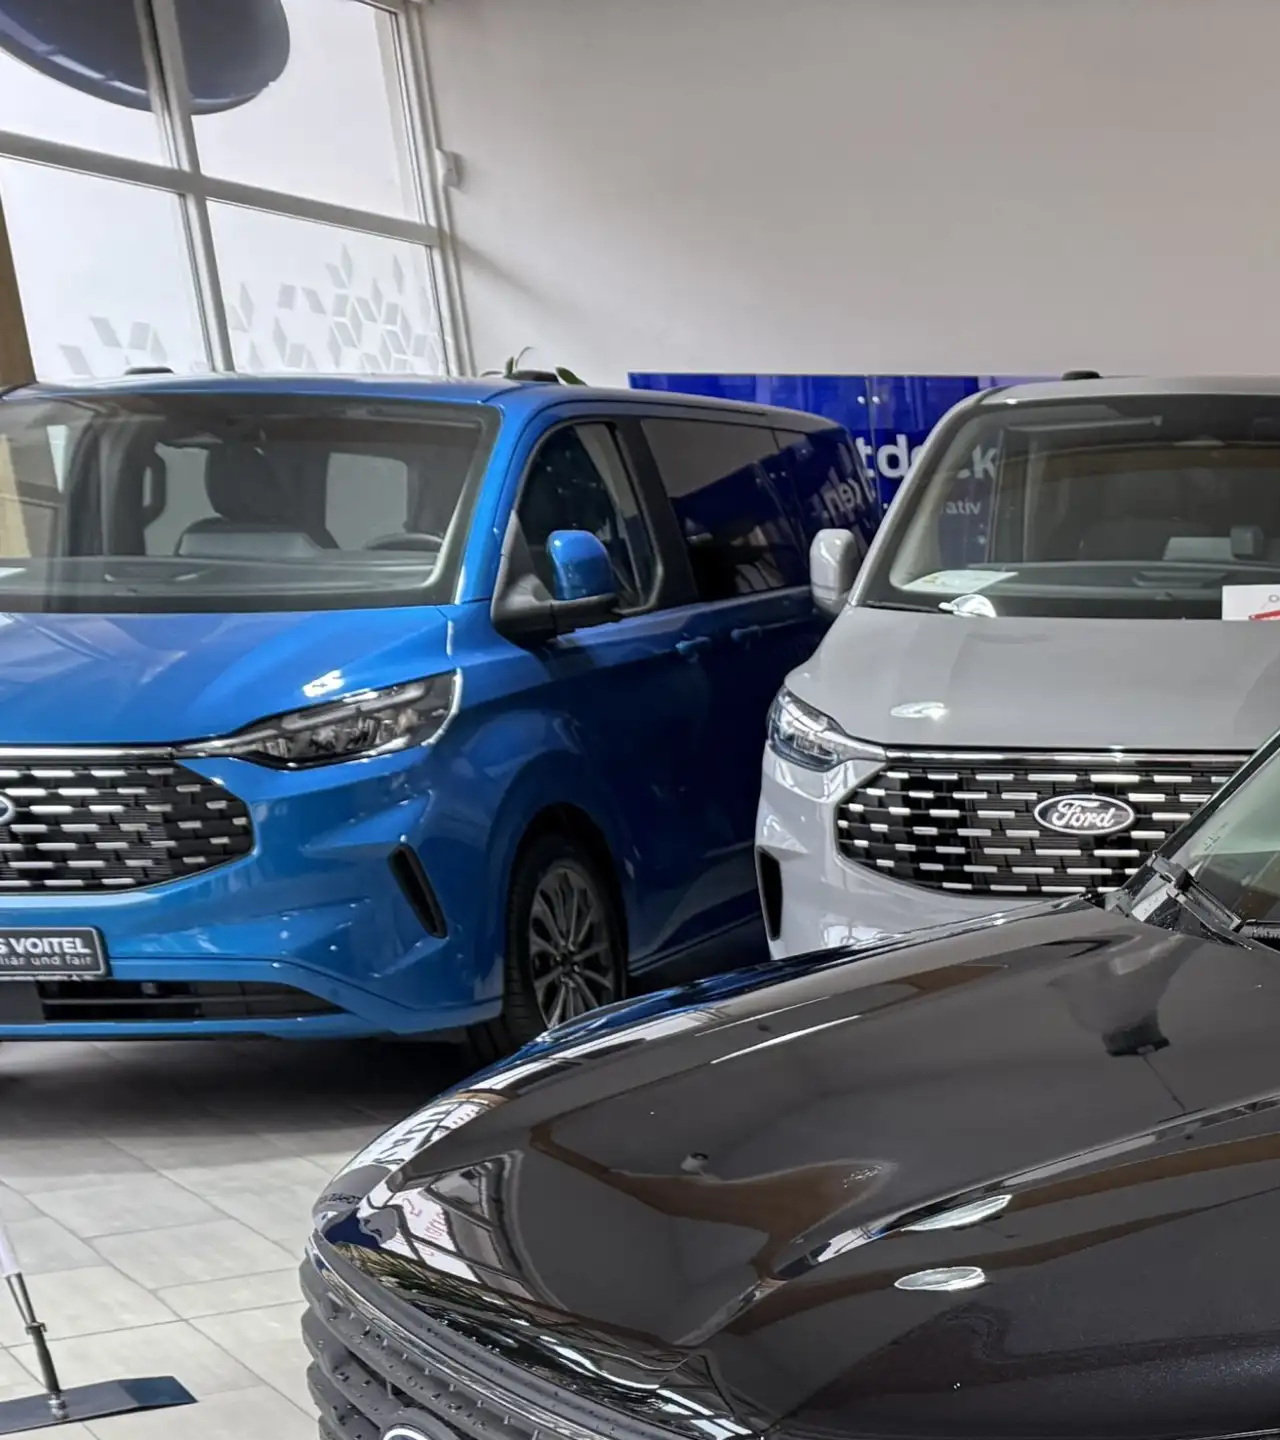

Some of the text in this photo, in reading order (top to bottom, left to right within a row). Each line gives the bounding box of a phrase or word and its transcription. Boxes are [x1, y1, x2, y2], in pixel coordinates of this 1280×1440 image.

[1051, 799, 1116, 828] Ford
[8, 937, 93, 954] VOITEL
[65, 954, 92, 966] fair
